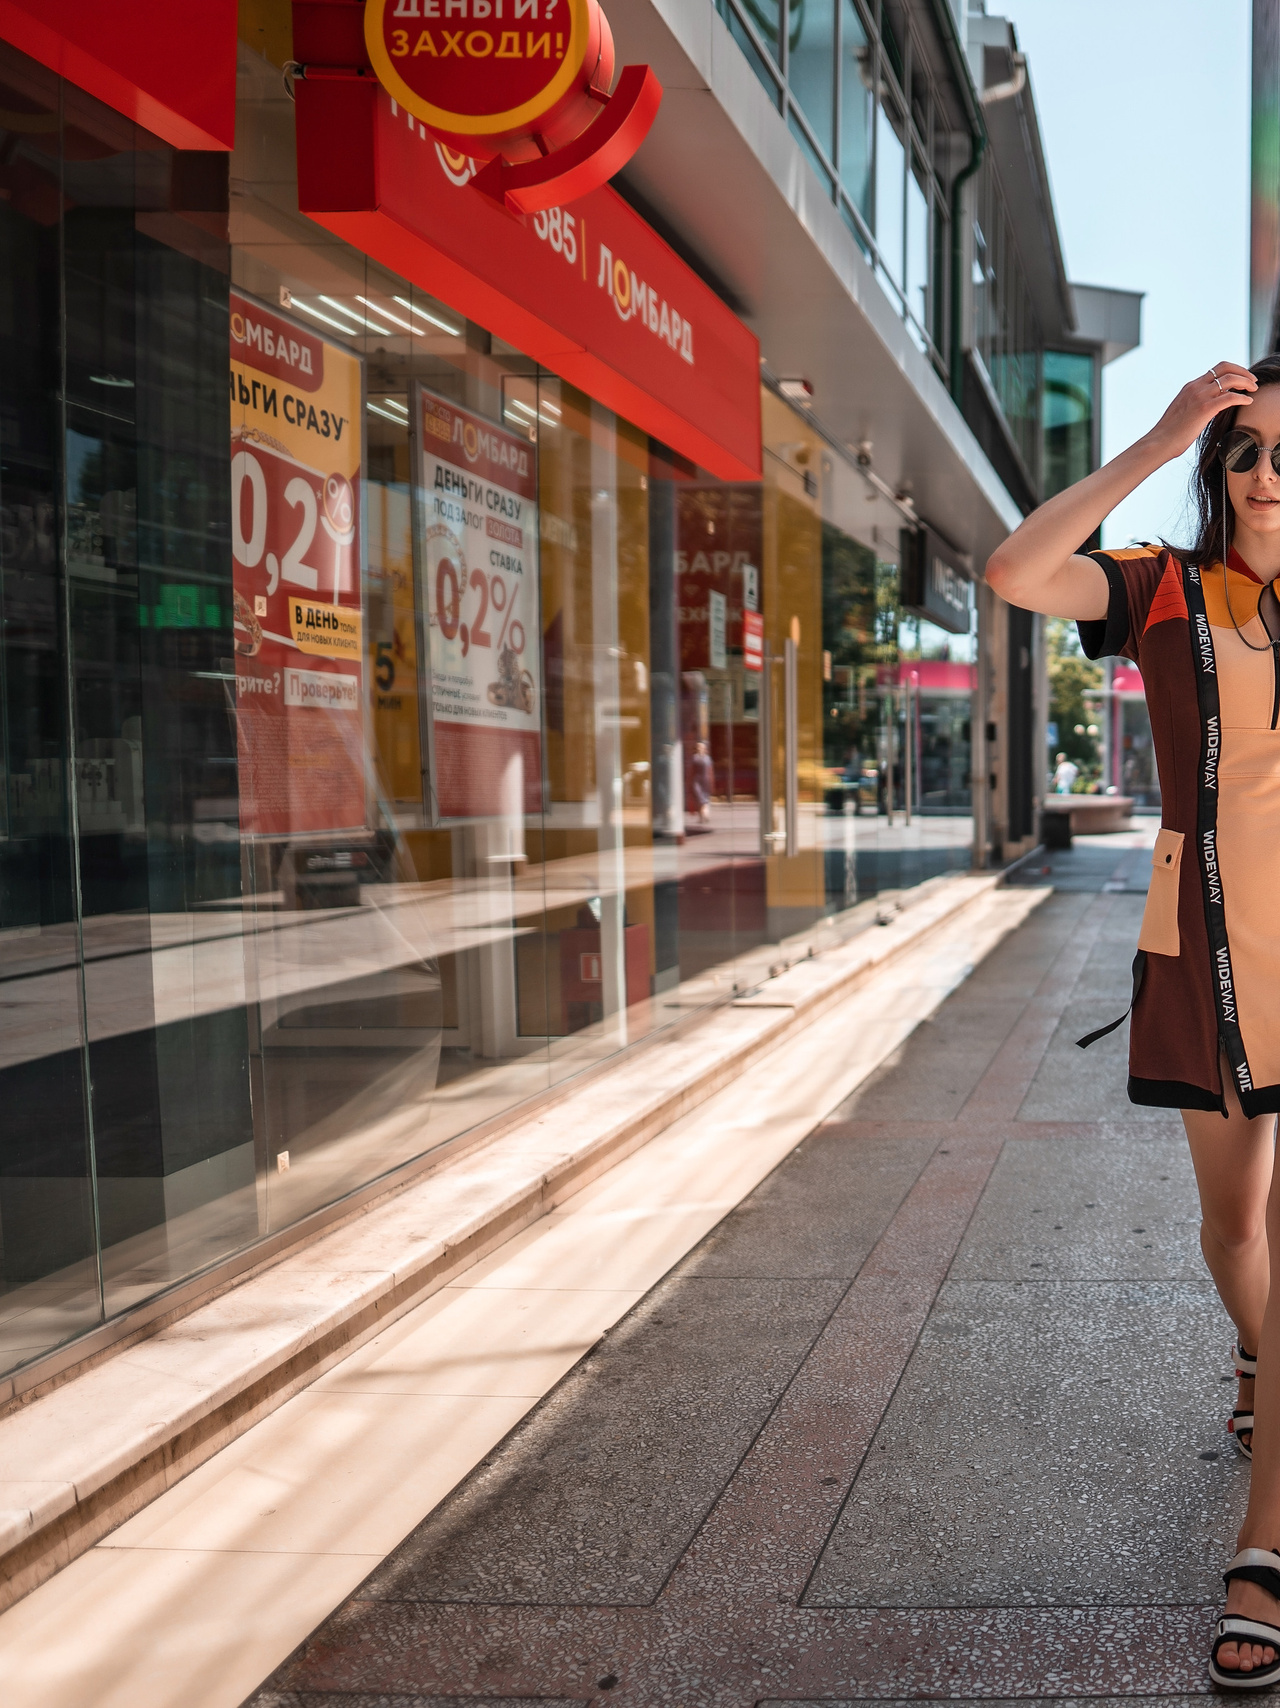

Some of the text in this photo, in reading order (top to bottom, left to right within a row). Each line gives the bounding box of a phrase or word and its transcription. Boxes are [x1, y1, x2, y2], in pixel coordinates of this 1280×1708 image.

[393, 0, 559, 19] ДЕНЬГИ?
[391, 29, 564, 59] ЗАХОДИ!
[599, 243, 694, 365] ЛОМБАРД
[452, 416, 528, 477] ЛОМБАРД
[434, 465, 521, 520] ДЕНЬГИ СРАЗУ
[489, 549, 523, 575] СТАВКА
[295, 605, 303, 624] В
[306, 608, 339, 630] ДЕНЬ
[1195, 613, 1215, 674] WIDEWAY
[1204, 716, 1219, 790] WIDEWAY
[1203, 829, 1222, 905] WIDEWAY
[1216, 946, 1236, 1023] WIDEWAY
